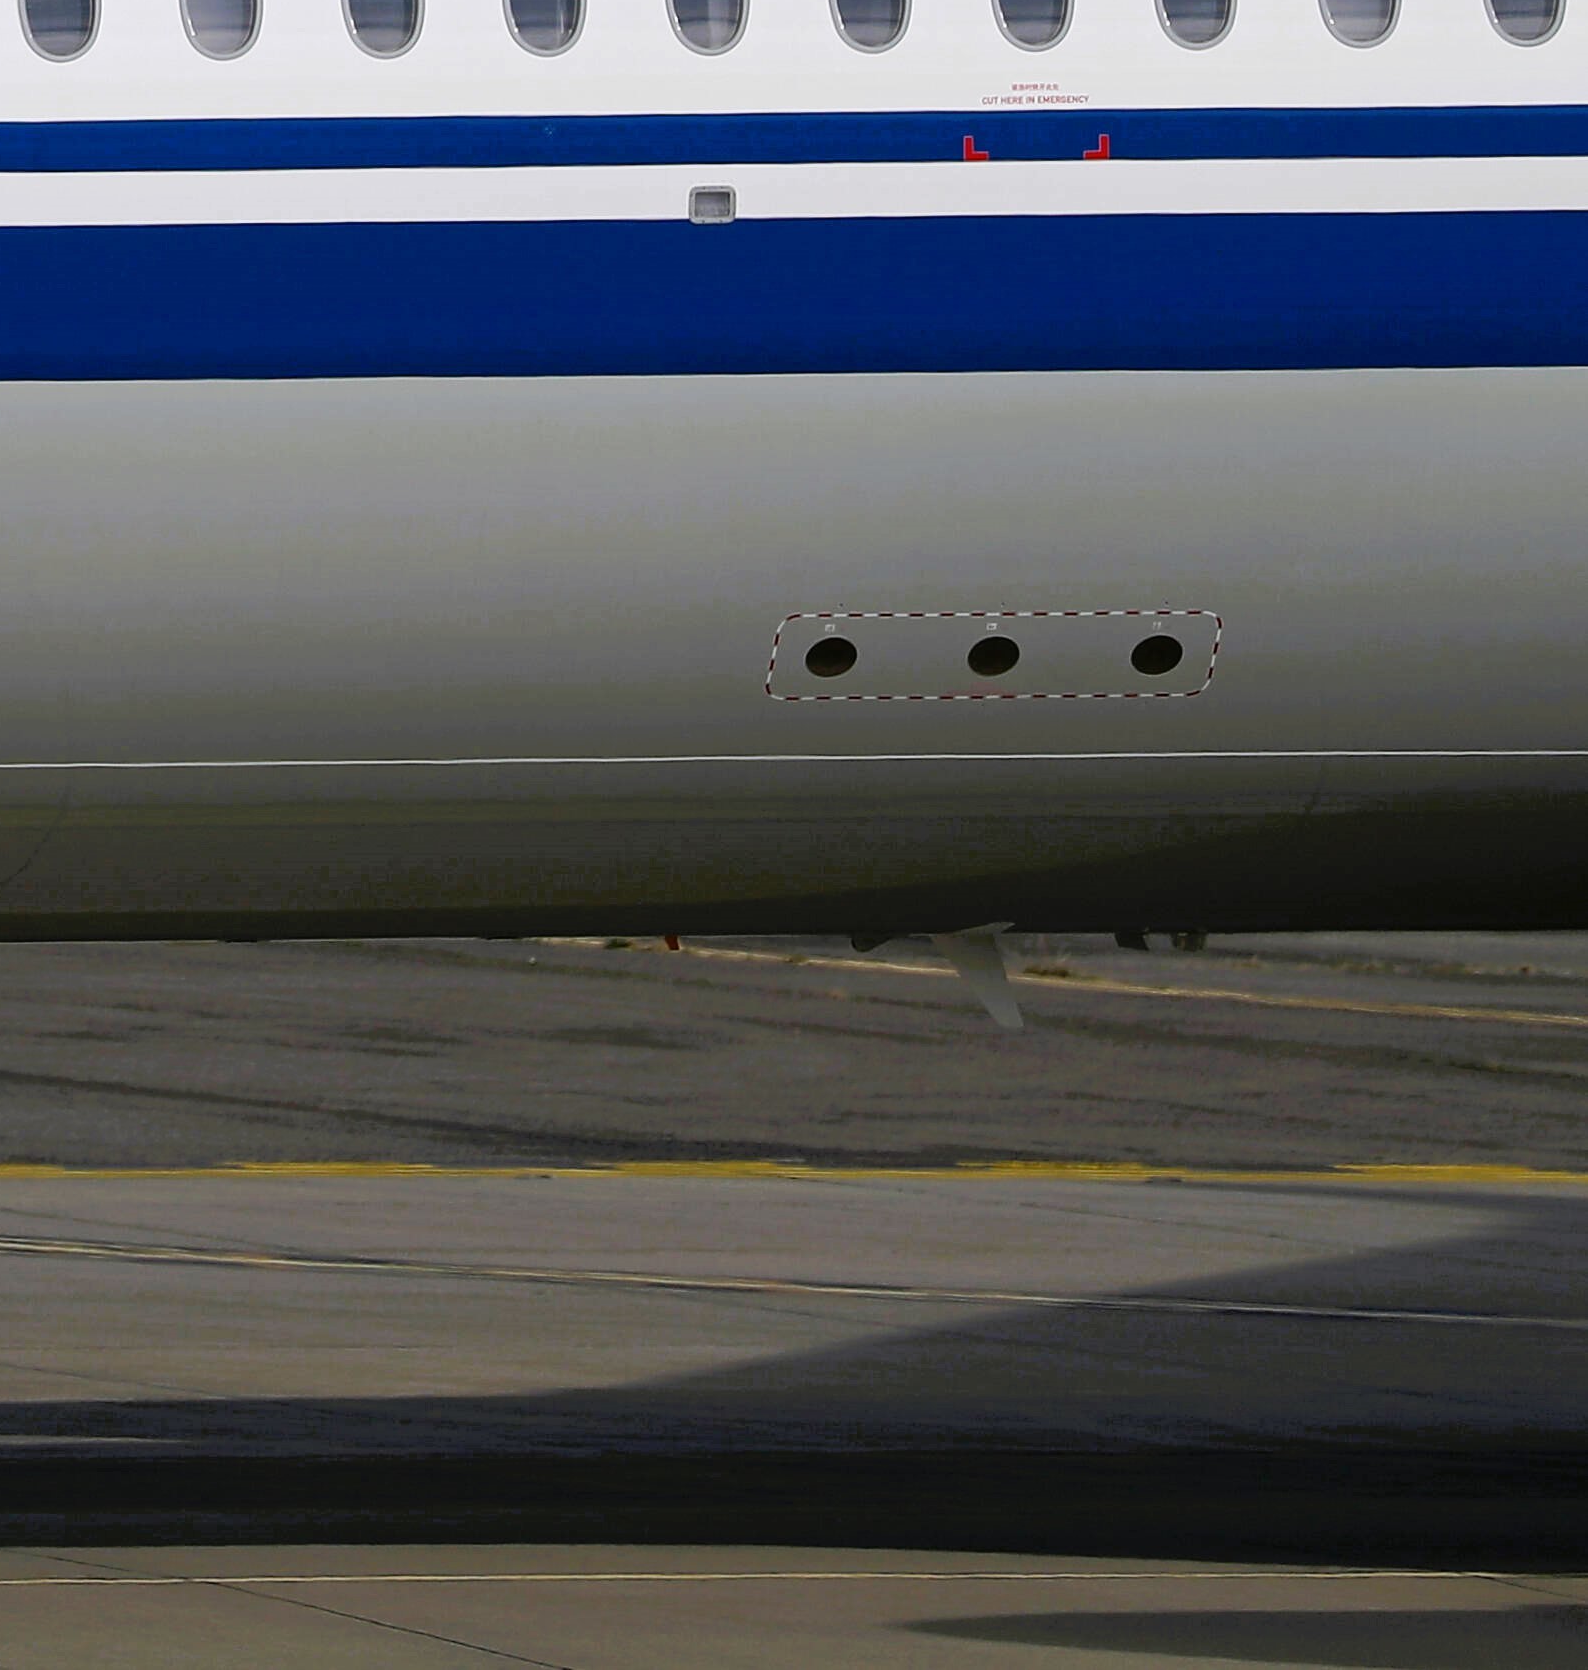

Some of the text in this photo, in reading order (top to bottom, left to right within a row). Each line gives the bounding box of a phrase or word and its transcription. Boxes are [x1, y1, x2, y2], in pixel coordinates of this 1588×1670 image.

[981, 95, 1090, 105] CUT HERE IN EMERGENCY
